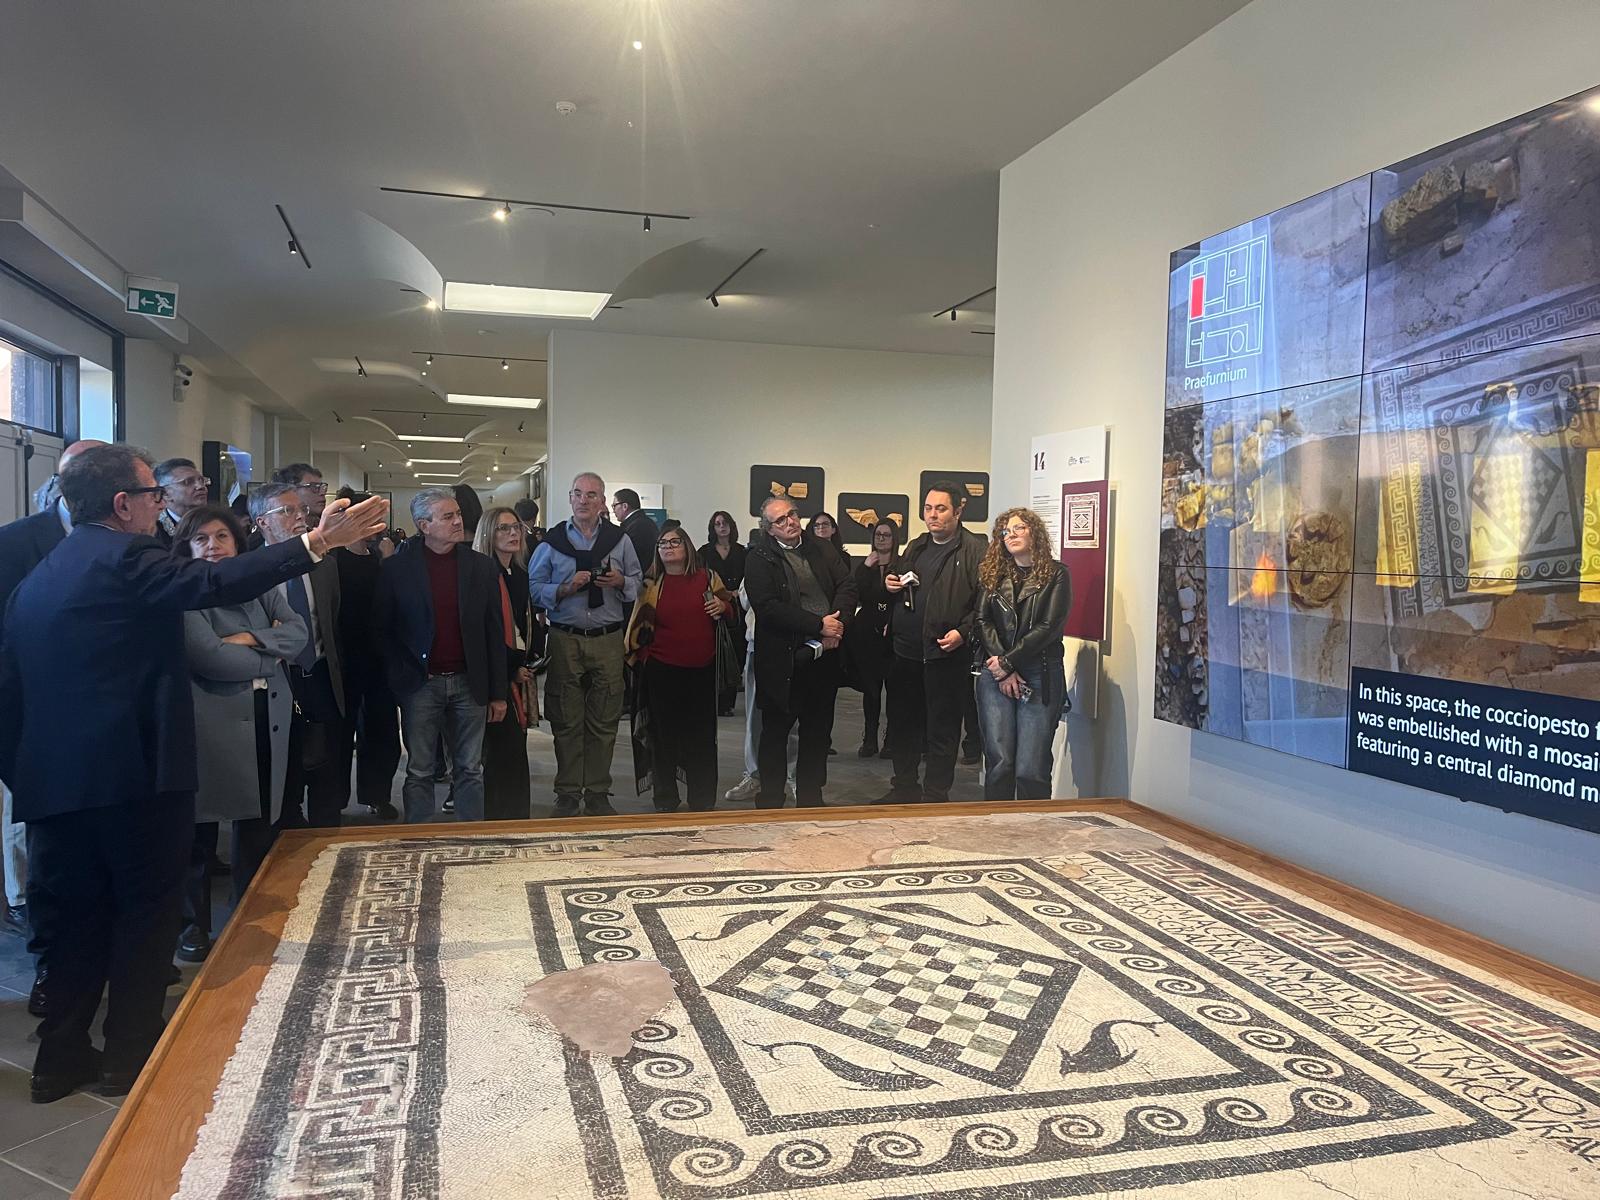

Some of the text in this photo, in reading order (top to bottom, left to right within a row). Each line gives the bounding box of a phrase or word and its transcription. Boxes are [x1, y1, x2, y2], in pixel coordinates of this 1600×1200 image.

[1184, 368, 1247, 390] Praefurnium
[1034, 452, 1045, 471] 14
[1357, 710, 1384, 728] was
[1388, 716, 1480, 747] embellished
[1485, 733, 1523, 757] with
[1527, 744, 1538, 760] a
[1359, 682, 1372, 700] In
[1376, 687, 1402, 706] this
[1405, 693, 1452, 718] space,
[1454, 699, 1481, 719] the
[1486, 707, 1590, 739] cocciopesto
[1357, 732, 1420, 766] featuring
[1423, 750, 1433, 765] a
[1437, 753, 1493, 779] central
[1497, 764, 1576, 798] diamond
